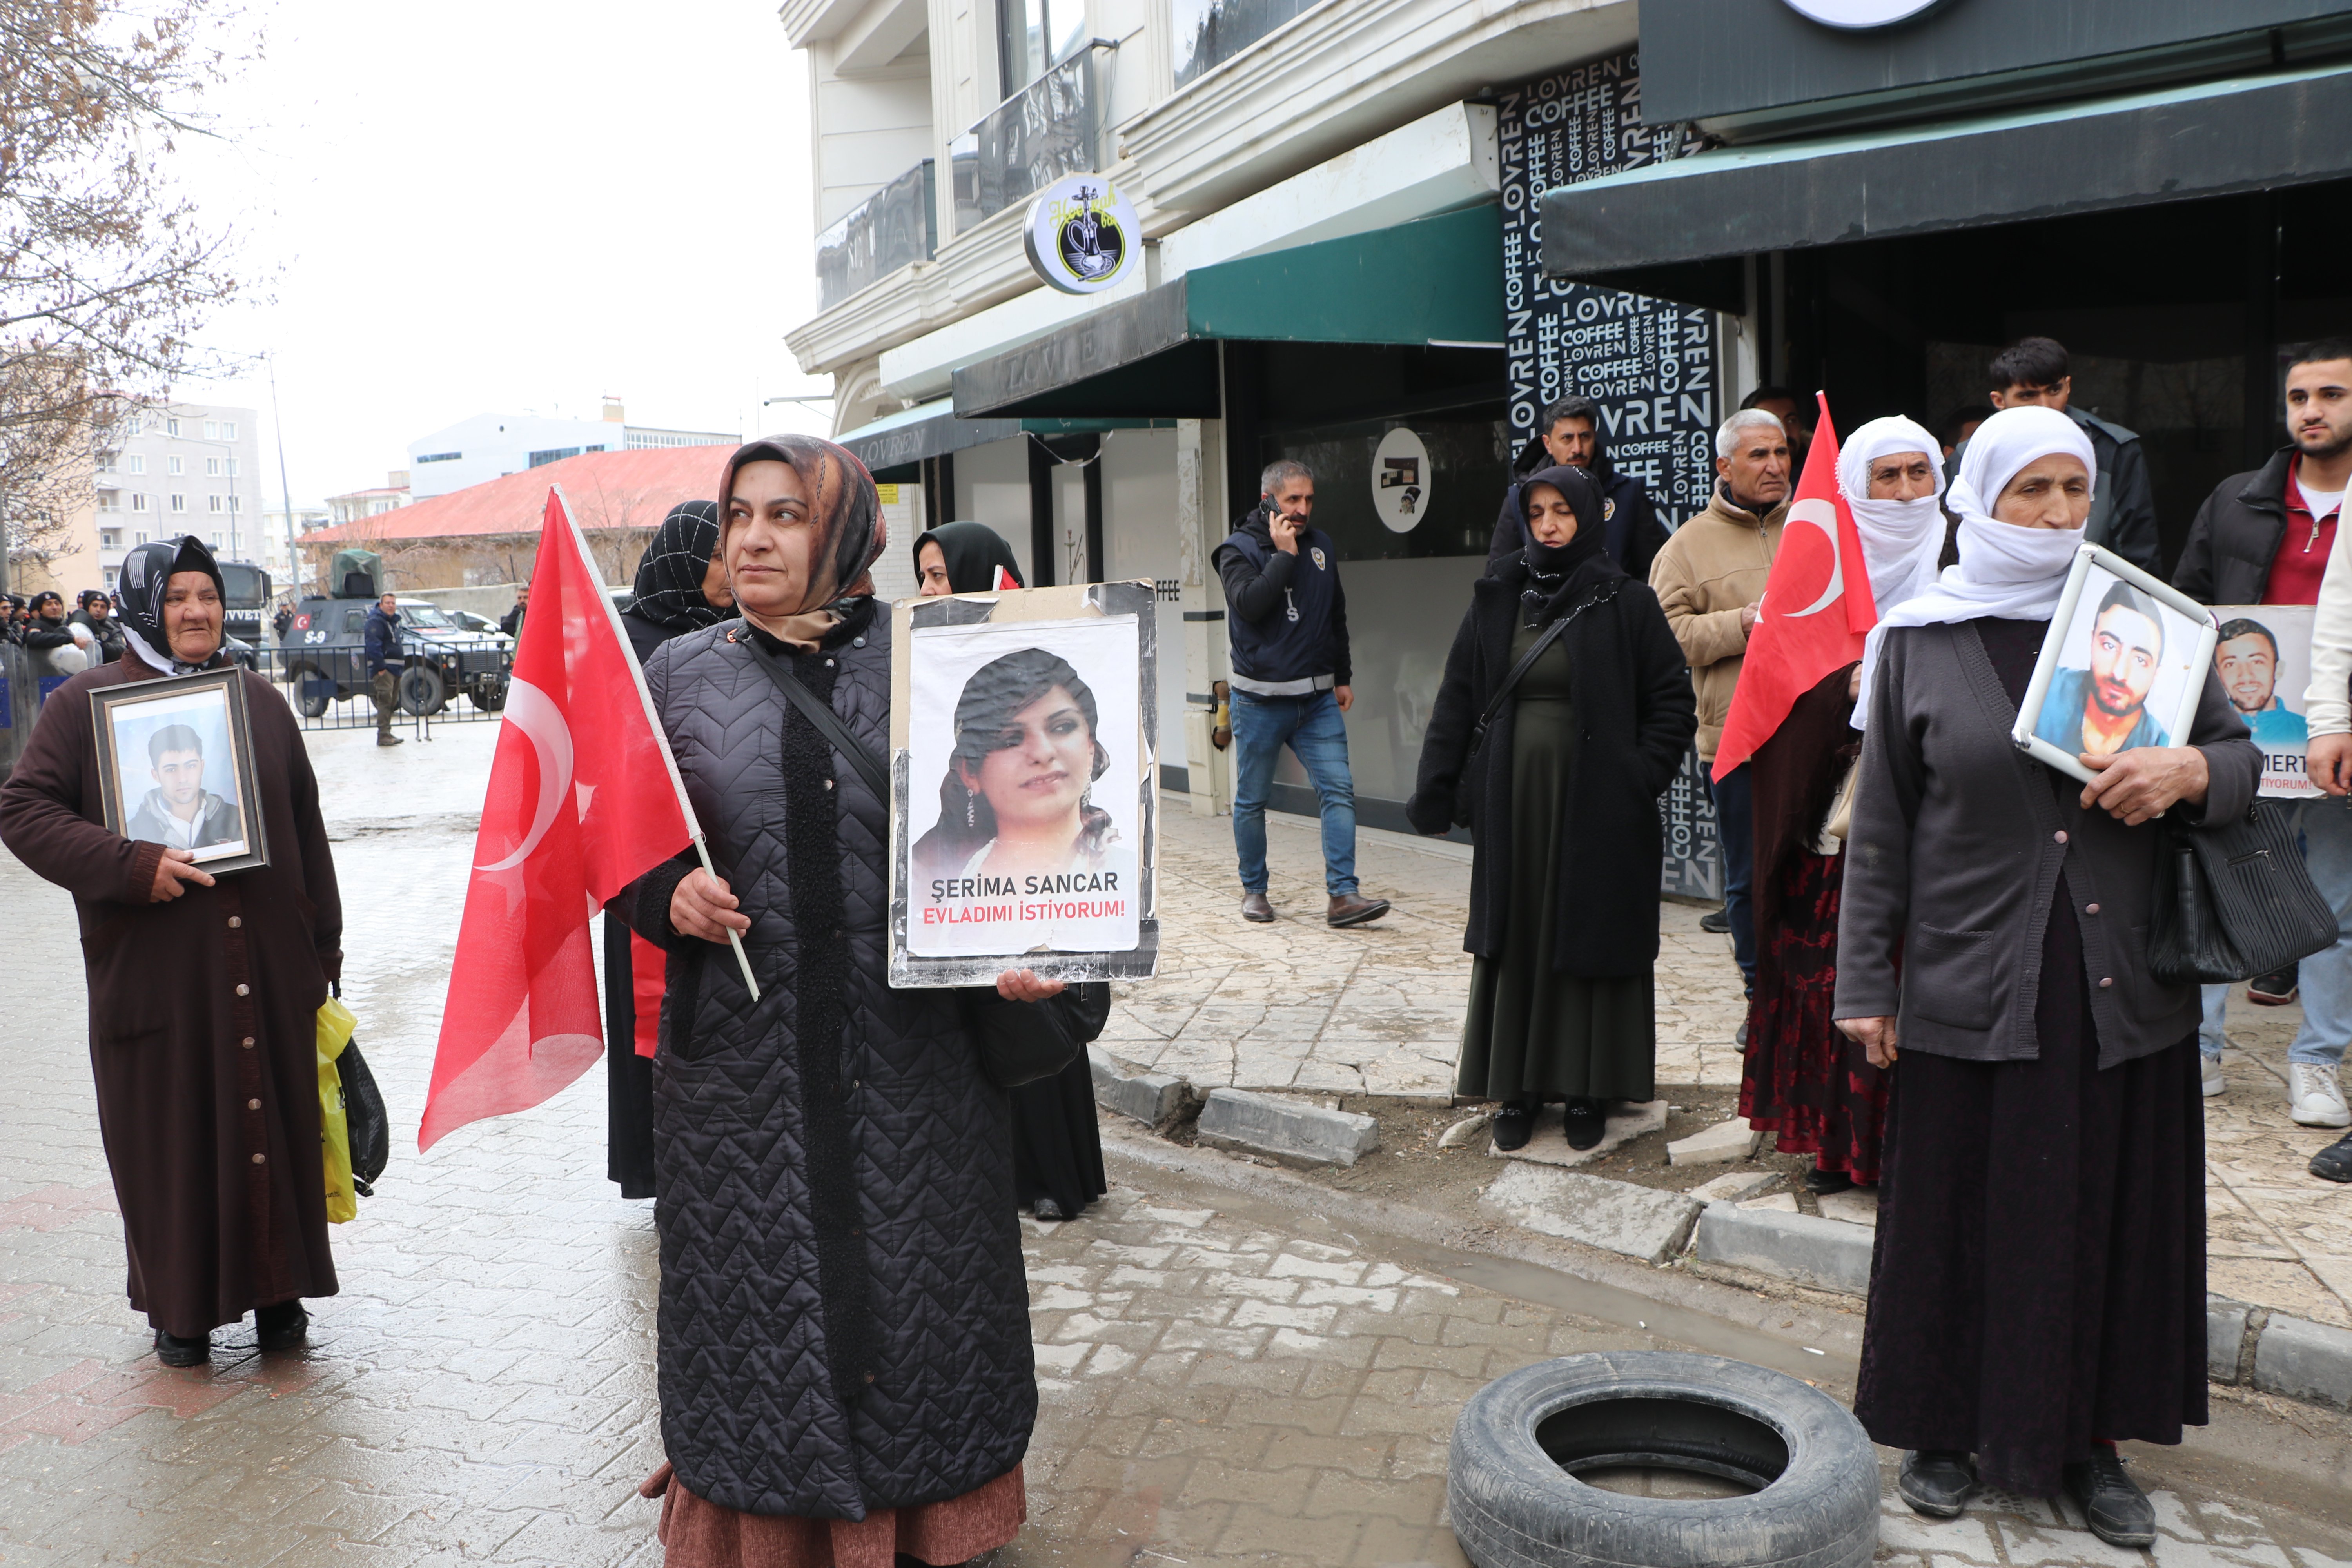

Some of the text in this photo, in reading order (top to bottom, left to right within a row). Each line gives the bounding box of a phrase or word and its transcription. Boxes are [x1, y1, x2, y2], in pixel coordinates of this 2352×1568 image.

[1527, 56, 1621, 105] LOVREN
[1526, 83, 1614, 128] COFFEE
[1621, 77, 1651, 172] VREN
[1568, 116, 1583, 172] COFFEE
[1587, 110, 1600, 171] LOVREN
[1602, 108, 1616, 161] COFFEE
[1500, 92, 1525, 230] LOVREN
[1551, 129, 1564, 188] LOVREN
[1504, 232, 1523, 311] COFFEE
[1563, 291, 1677, 326] LOVRE
[1561, 321, 1625, 347] COFFEE
[1564, 339, 1626, 363] LOVREN
[1630, 316, 1640, 354] COFFEE
[1643, 314, 1655, 372] LOVREN
[1659, 308, 1680, 394] COFFEE
[1684, 308, 1710, 391] VREN
[1508, 309, 1535, 446] LOVREN
[1538, 313, 1560, 405] COFFEE
[1564, 365, 1573, 396] VREN
[1577, 357, 1642, 382] COFFEE
[1580, 375, 1655, 400] LOVREN
[1595, 391, 1711, 437] VREN
[860, 428, 926, 463] LOVREN
[1621, 439, 1670, 457] COFFEE
[1673, 430, 1688, 504] LOVREN
[1691, 430, 1710, 507] COFFEE
[1156, 580, 1180, 601] FFEE
[304, 630, 326, 644] S-9
[2260, 776, 2312, 790] TİYORUM!
[1671, 777, 1691, 859] COFFEE
[931, 872, 1118, 903] ŞERİMA SANCAR
[924, 899, 1125, 924] EVLADIMI İSTİYORUM!
